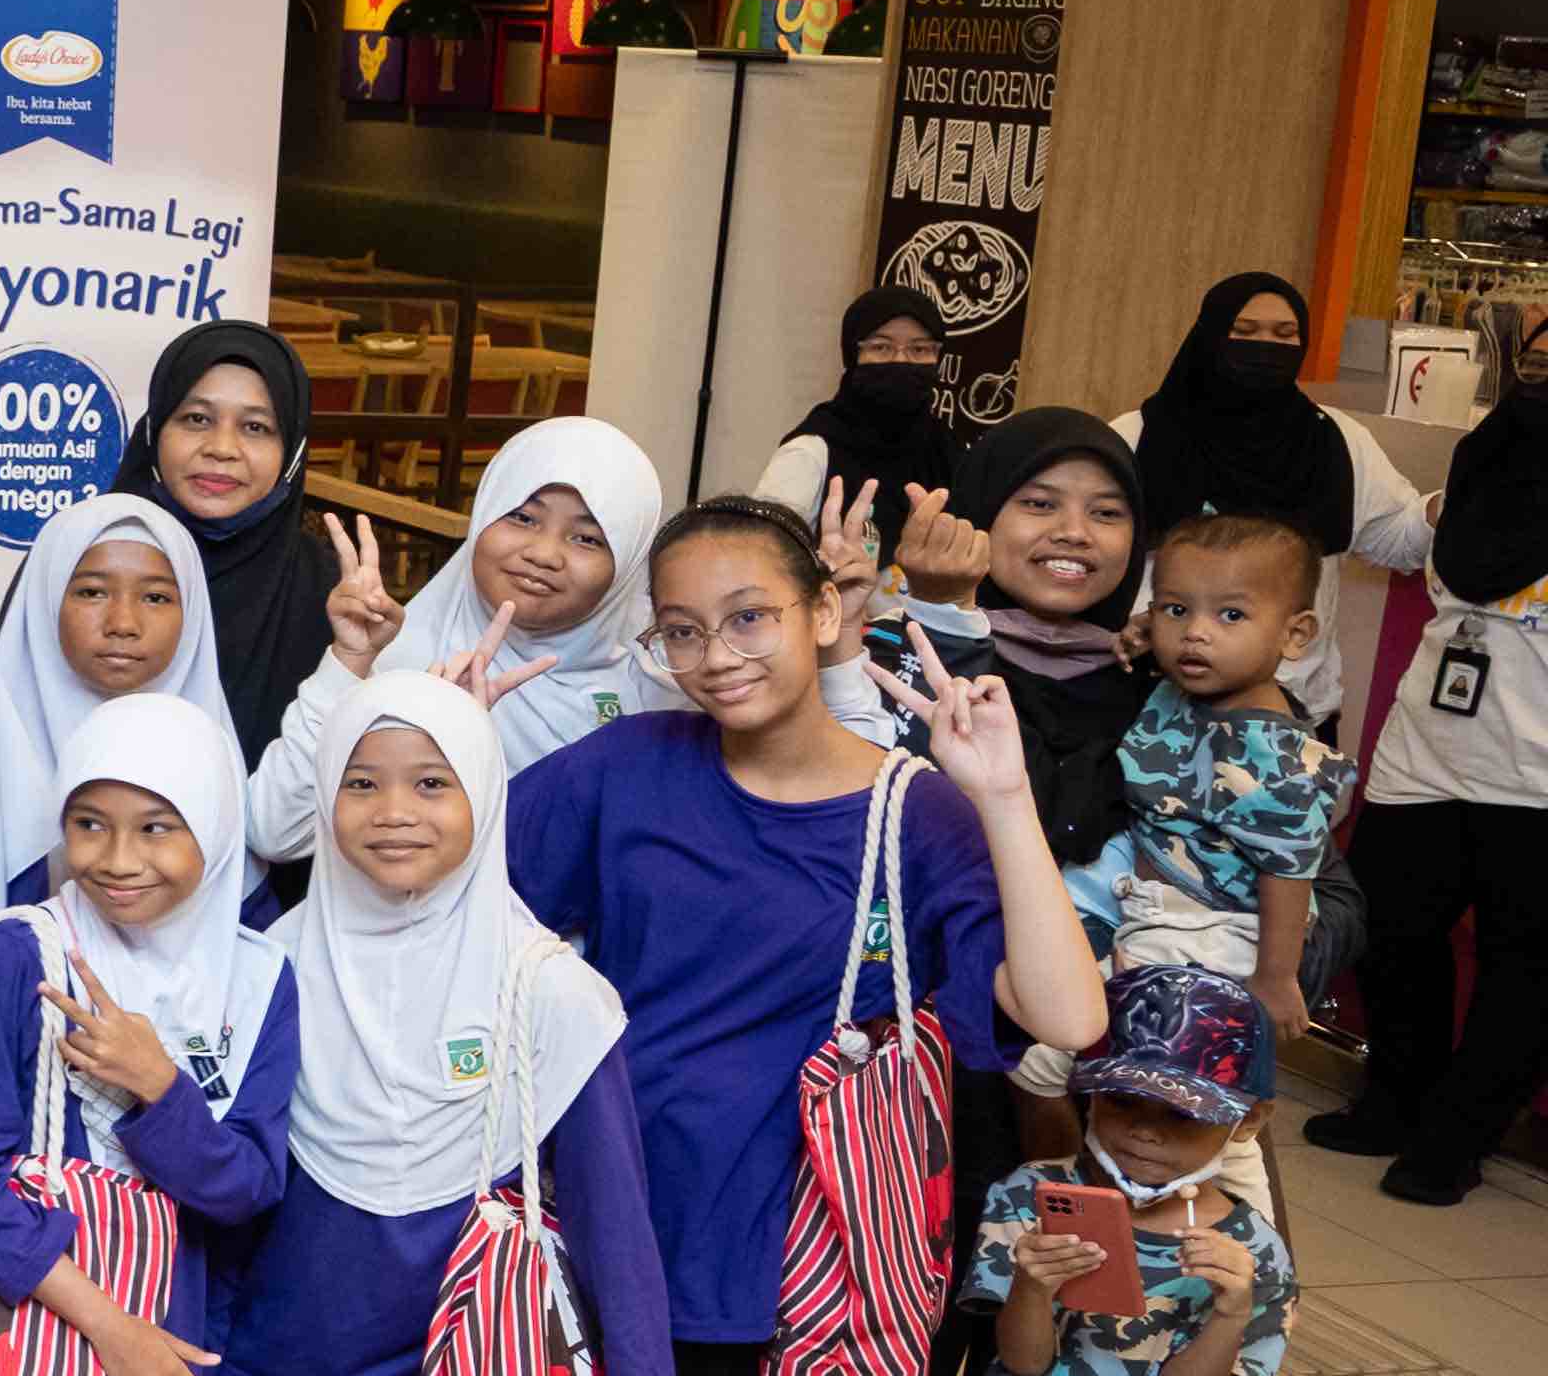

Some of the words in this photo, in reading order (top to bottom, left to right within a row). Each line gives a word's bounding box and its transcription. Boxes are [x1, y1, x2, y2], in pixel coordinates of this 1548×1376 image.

[907, 16, 1021, 54] MAKANAN
[31, 95, 55, 110] kita
[57, 96, 92, 112] hebat
[904, 66, 956, 104] NASI
[961, 69, 1056, 110] GORENG
[20, 110, 76, 126] bersama.
[891, 115, 1053, 212] MENU
[165, 196, 244, 258] Lagi
[61, 438, 97, 459] Asli
[0, 461, 72, 485] dengan
[1095, 1066, 1203, 1109] VENOM
